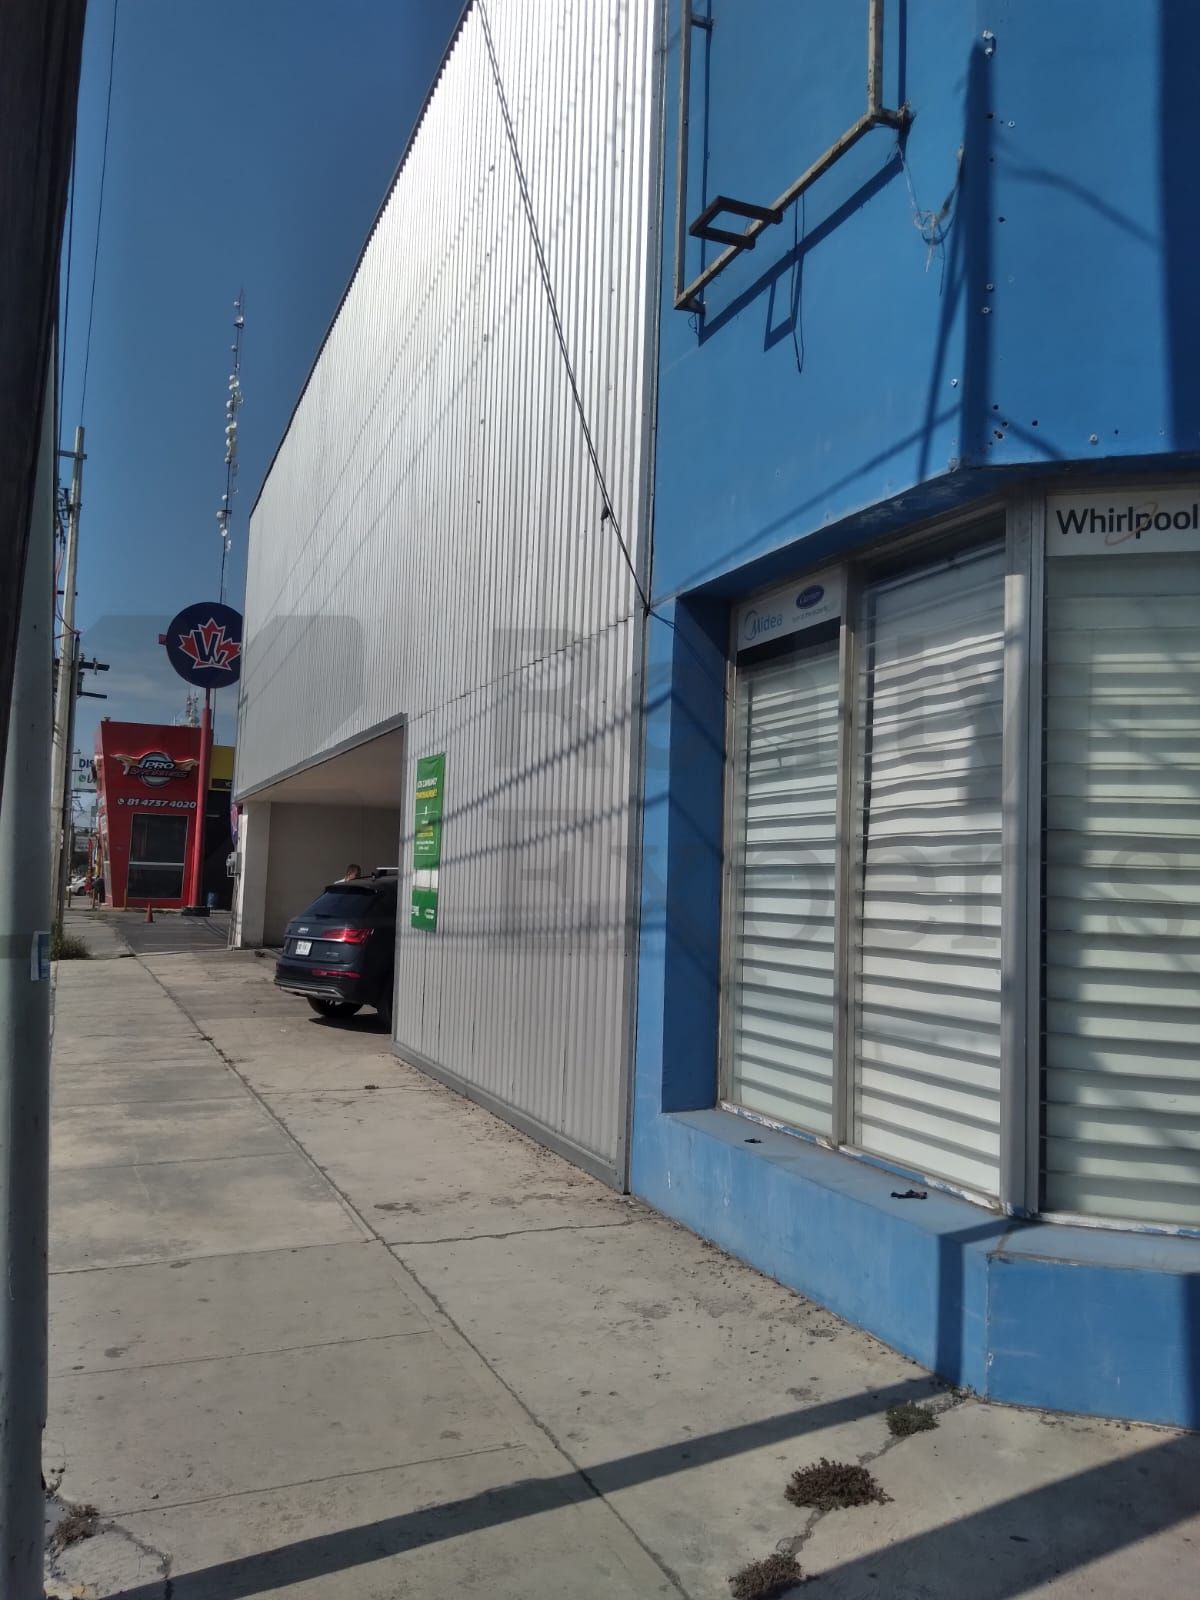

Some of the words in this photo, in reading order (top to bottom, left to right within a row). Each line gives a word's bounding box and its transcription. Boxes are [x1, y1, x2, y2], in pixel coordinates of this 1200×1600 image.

[1056, 504, 1198, 539] Whirlpool
[744, 609, 783, 641] Midea
[145, 761, 175, 769] PRO
[127, 798, 140, 806] 81
[141, 799, 169, 807] 4737
[170, 800, 197, 809] 4020
